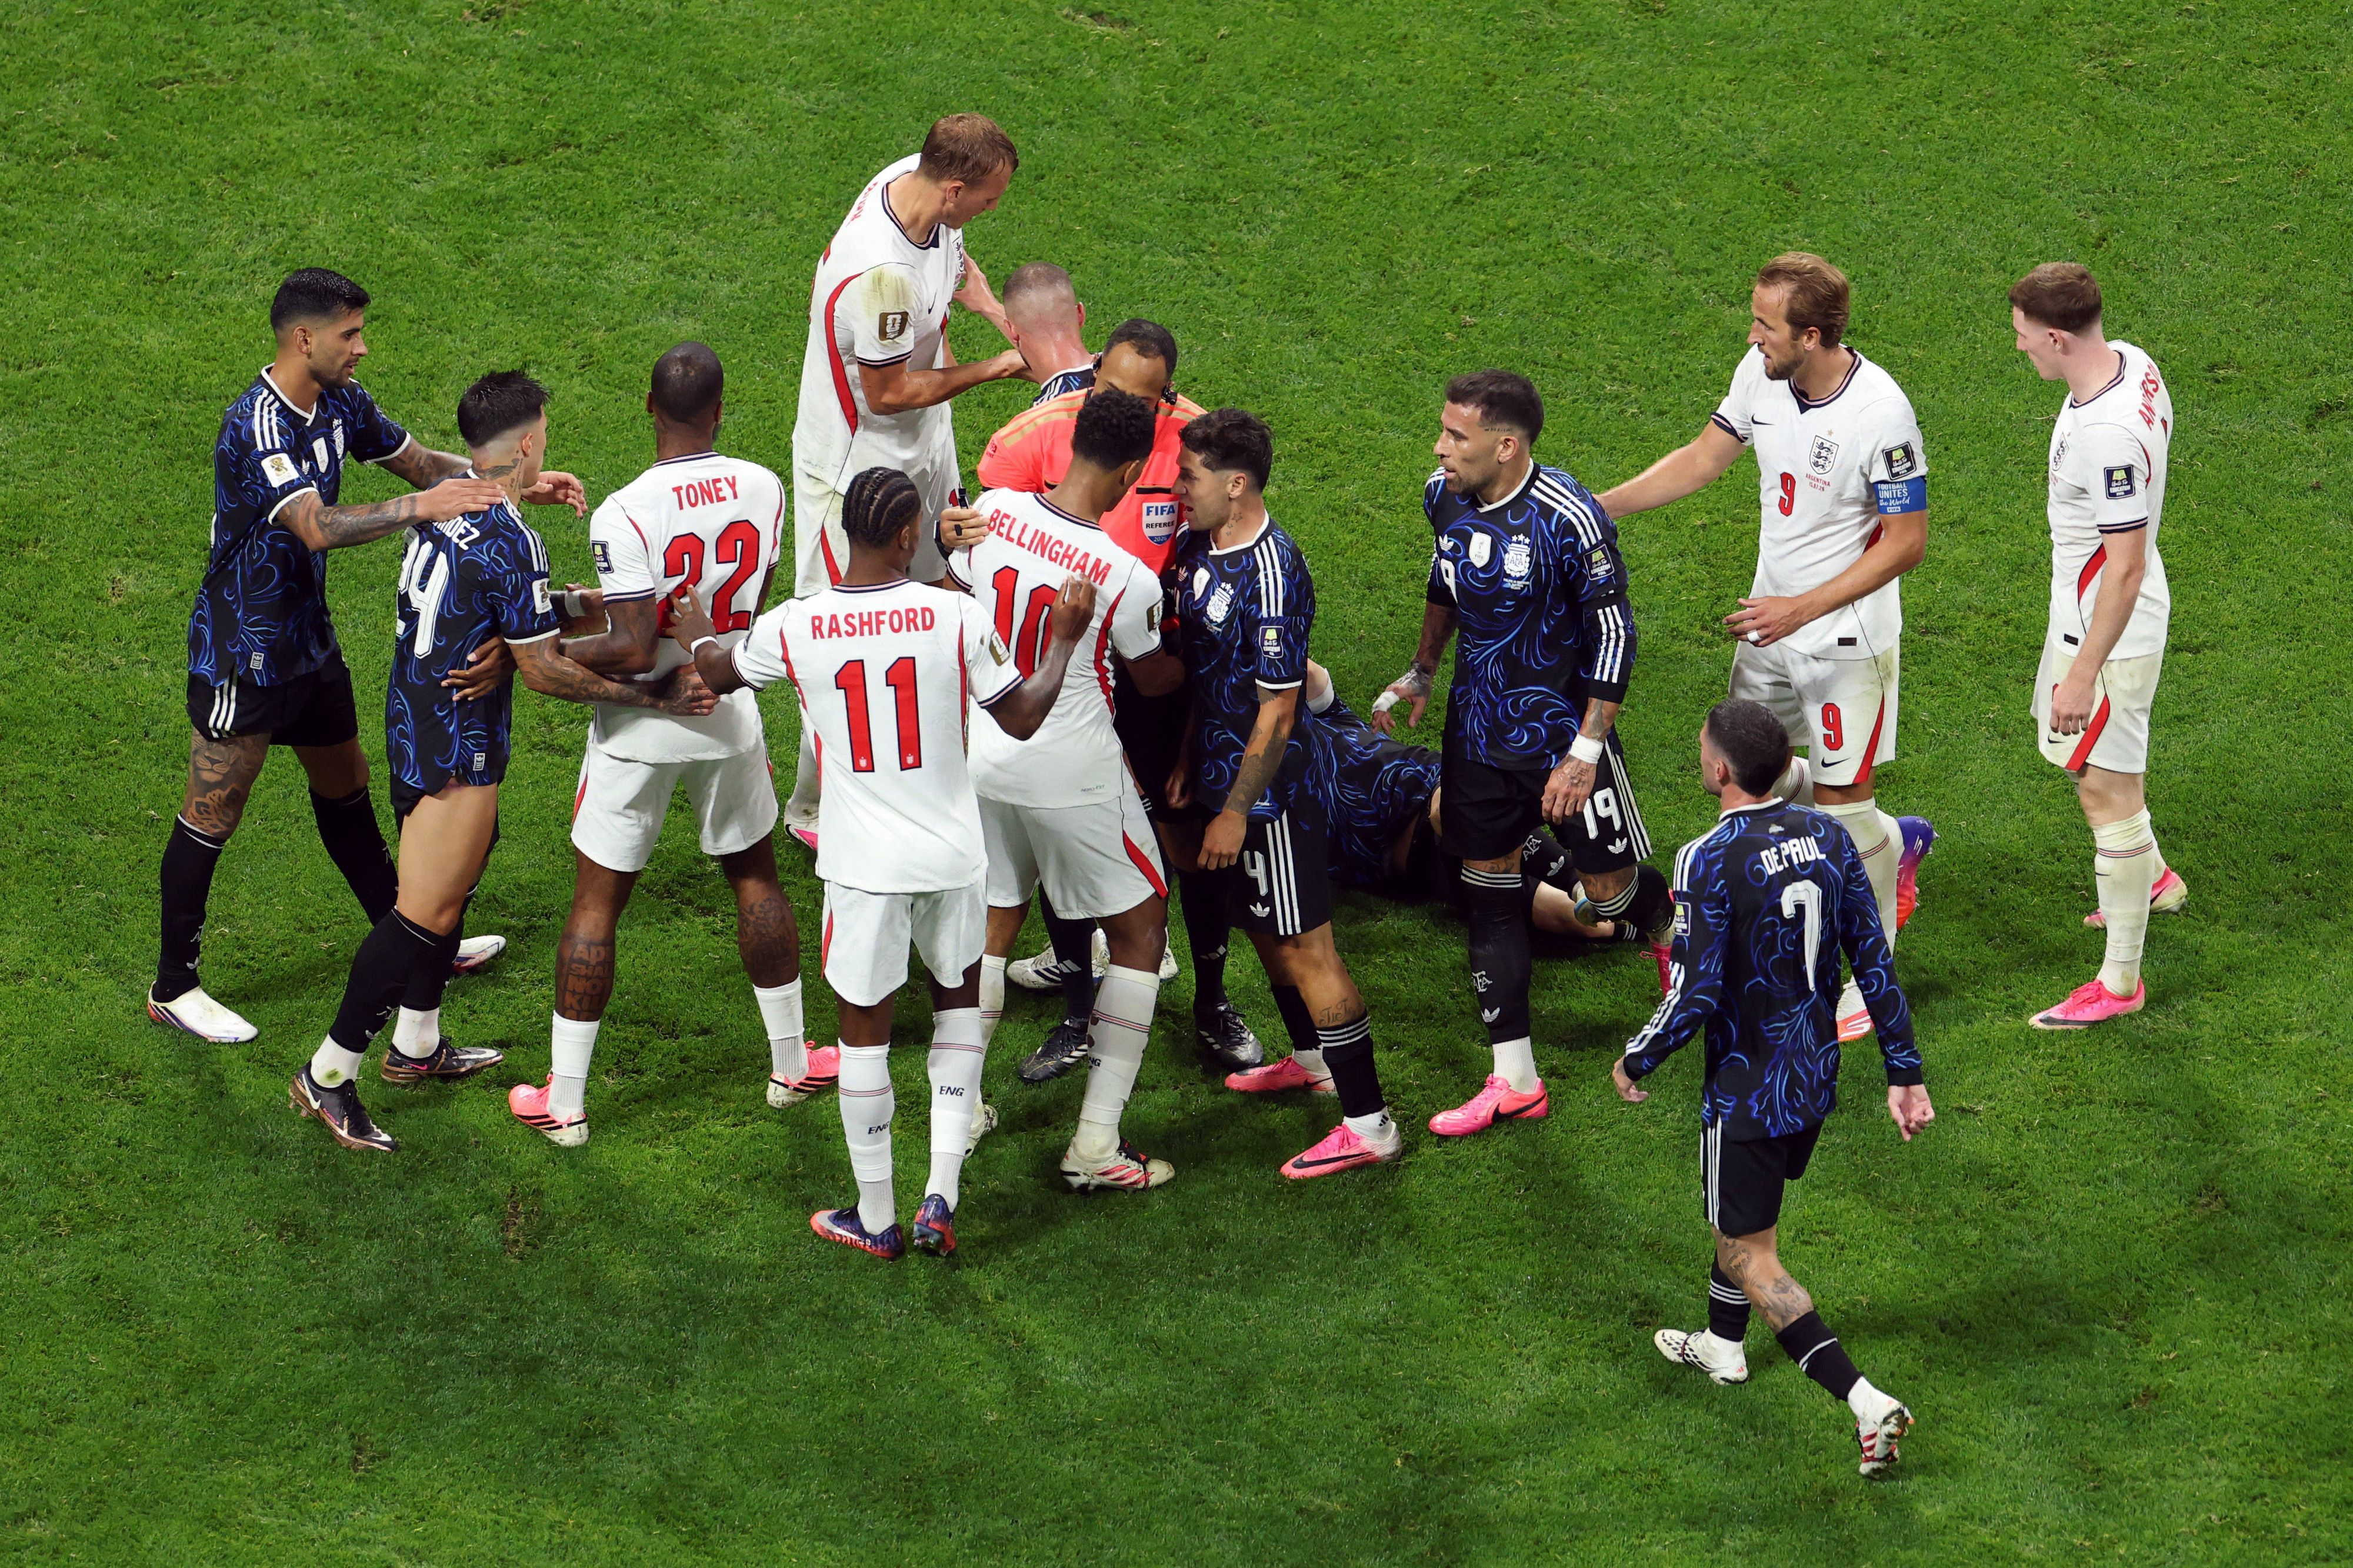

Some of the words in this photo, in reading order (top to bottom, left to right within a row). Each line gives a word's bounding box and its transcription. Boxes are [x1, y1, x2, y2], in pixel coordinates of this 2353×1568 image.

[672, 475, 738, 510] TONEY
[1778, 471, 1796, 516] 9
[1806, 473, 1830, 486] ARGENTINA
[1879, 489, 1908, 498] UNITES
[1146, 505, 1175, 516] FIFA
[1889, 497, 1910, 506] World
[1145, 521, 1175, 529] REFEREE
[988, 508, 1112, 586] BELLINGHAM
[656, 519, 760, 638] 22
[811, 607, 935, 639] RASHFORD
[992, 565, 1058, 679] 10
[835, 656, 922, 772] 11
[1821, 703, 1843, 750] 9
[1583, 787, 1621, 839] 19
[1779, 836, 1826, 867] PAUL
[1244, 850, 1268, 896] 4
[1781, 879, 1822, 992] 7
[1089, 1057, 1101, 1067] NG
[939, 1086, 965, 1097] ENG
[868, 1121, 890, 1135] ENG
